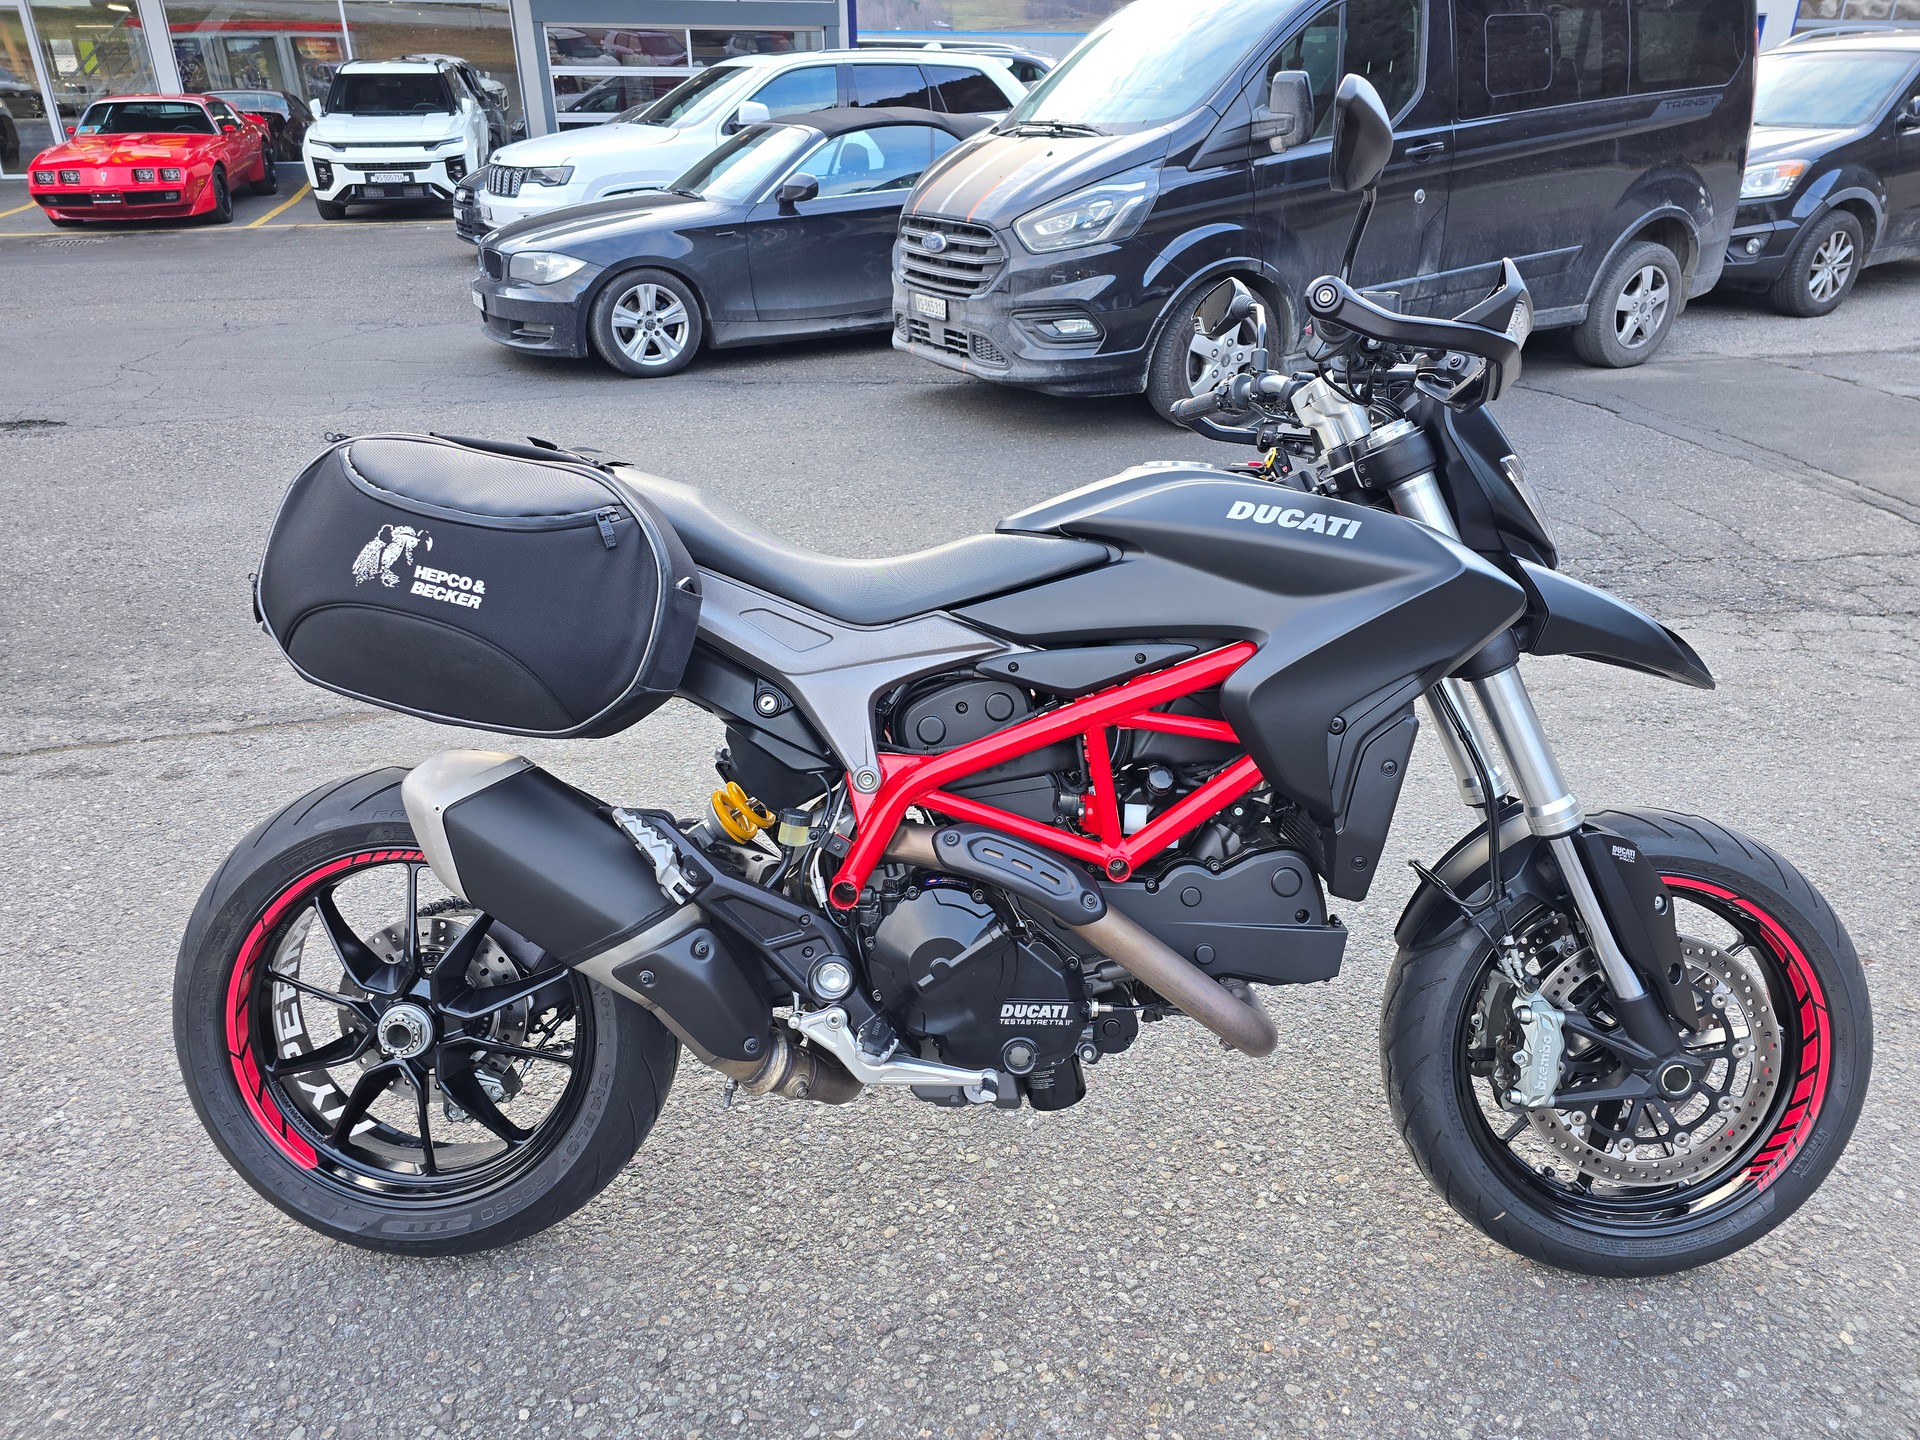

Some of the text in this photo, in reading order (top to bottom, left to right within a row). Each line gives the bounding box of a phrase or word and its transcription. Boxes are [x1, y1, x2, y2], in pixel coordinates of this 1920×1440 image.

[1665, 97, 1716, 109] TRANSIT
[1226, 501, 1362, 539] DUCATI
[414, 565, 486, 594] HEPCO &
[410, 581, 482, 609] BECKER
[1612, 845, 1635, 857] DUCATI
[999, 1018, 1064, 1026] TESTASTRETTA
[1000, 1004, 1069, 1018] DUCATI
[1534, 1035, 1553, 1090] brembo
[566, 1071, 611, 1157] DIABLO
[480, 1176, 549, 1221] ROSSO
